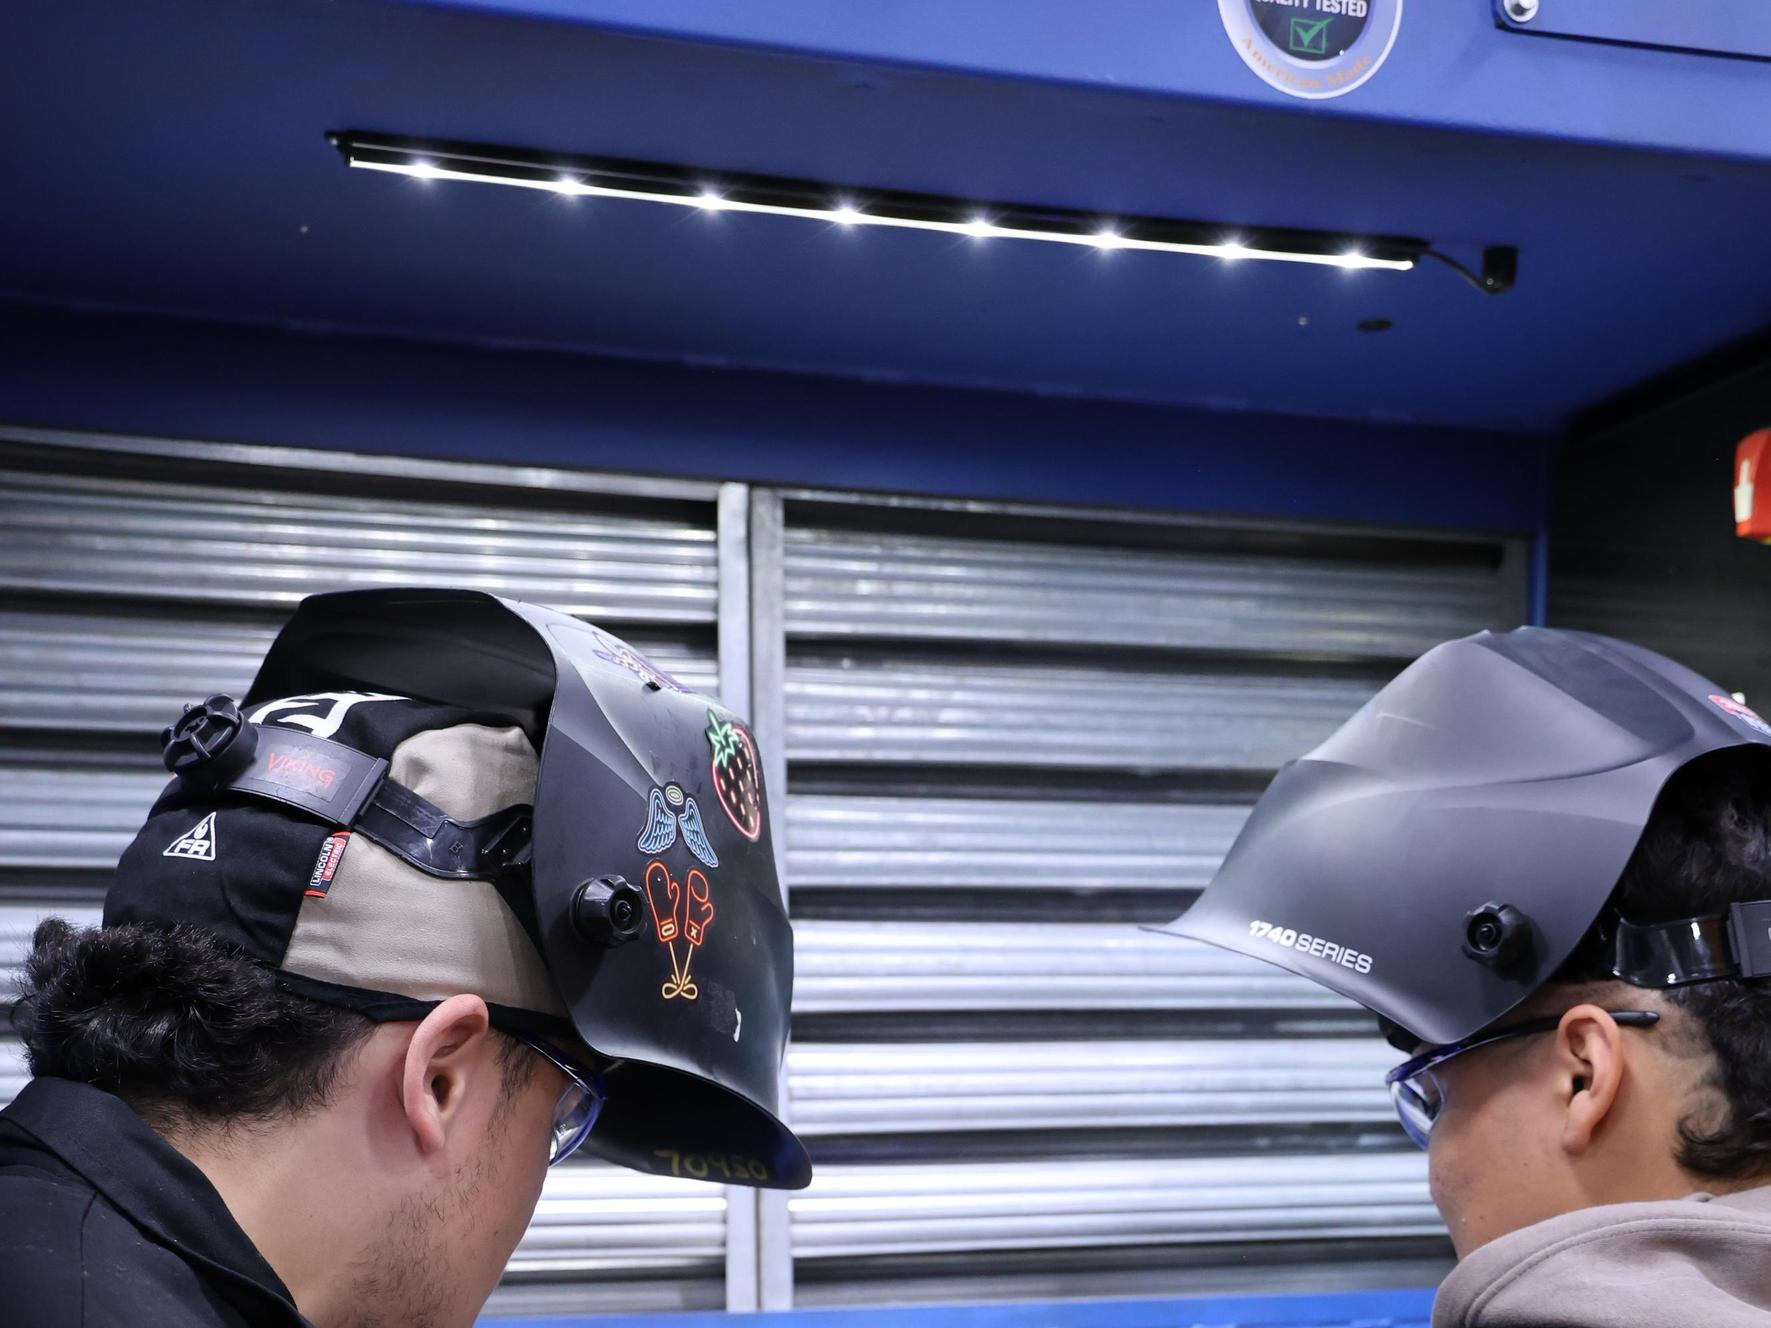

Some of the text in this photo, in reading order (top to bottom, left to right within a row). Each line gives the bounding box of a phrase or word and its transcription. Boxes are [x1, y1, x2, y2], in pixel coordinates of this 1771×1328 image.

[174, 839, 211, 856] FR
[312, 842, 335, 883] LINCOLN
[1249, 920, 1373, 974] 1740 SERIES
